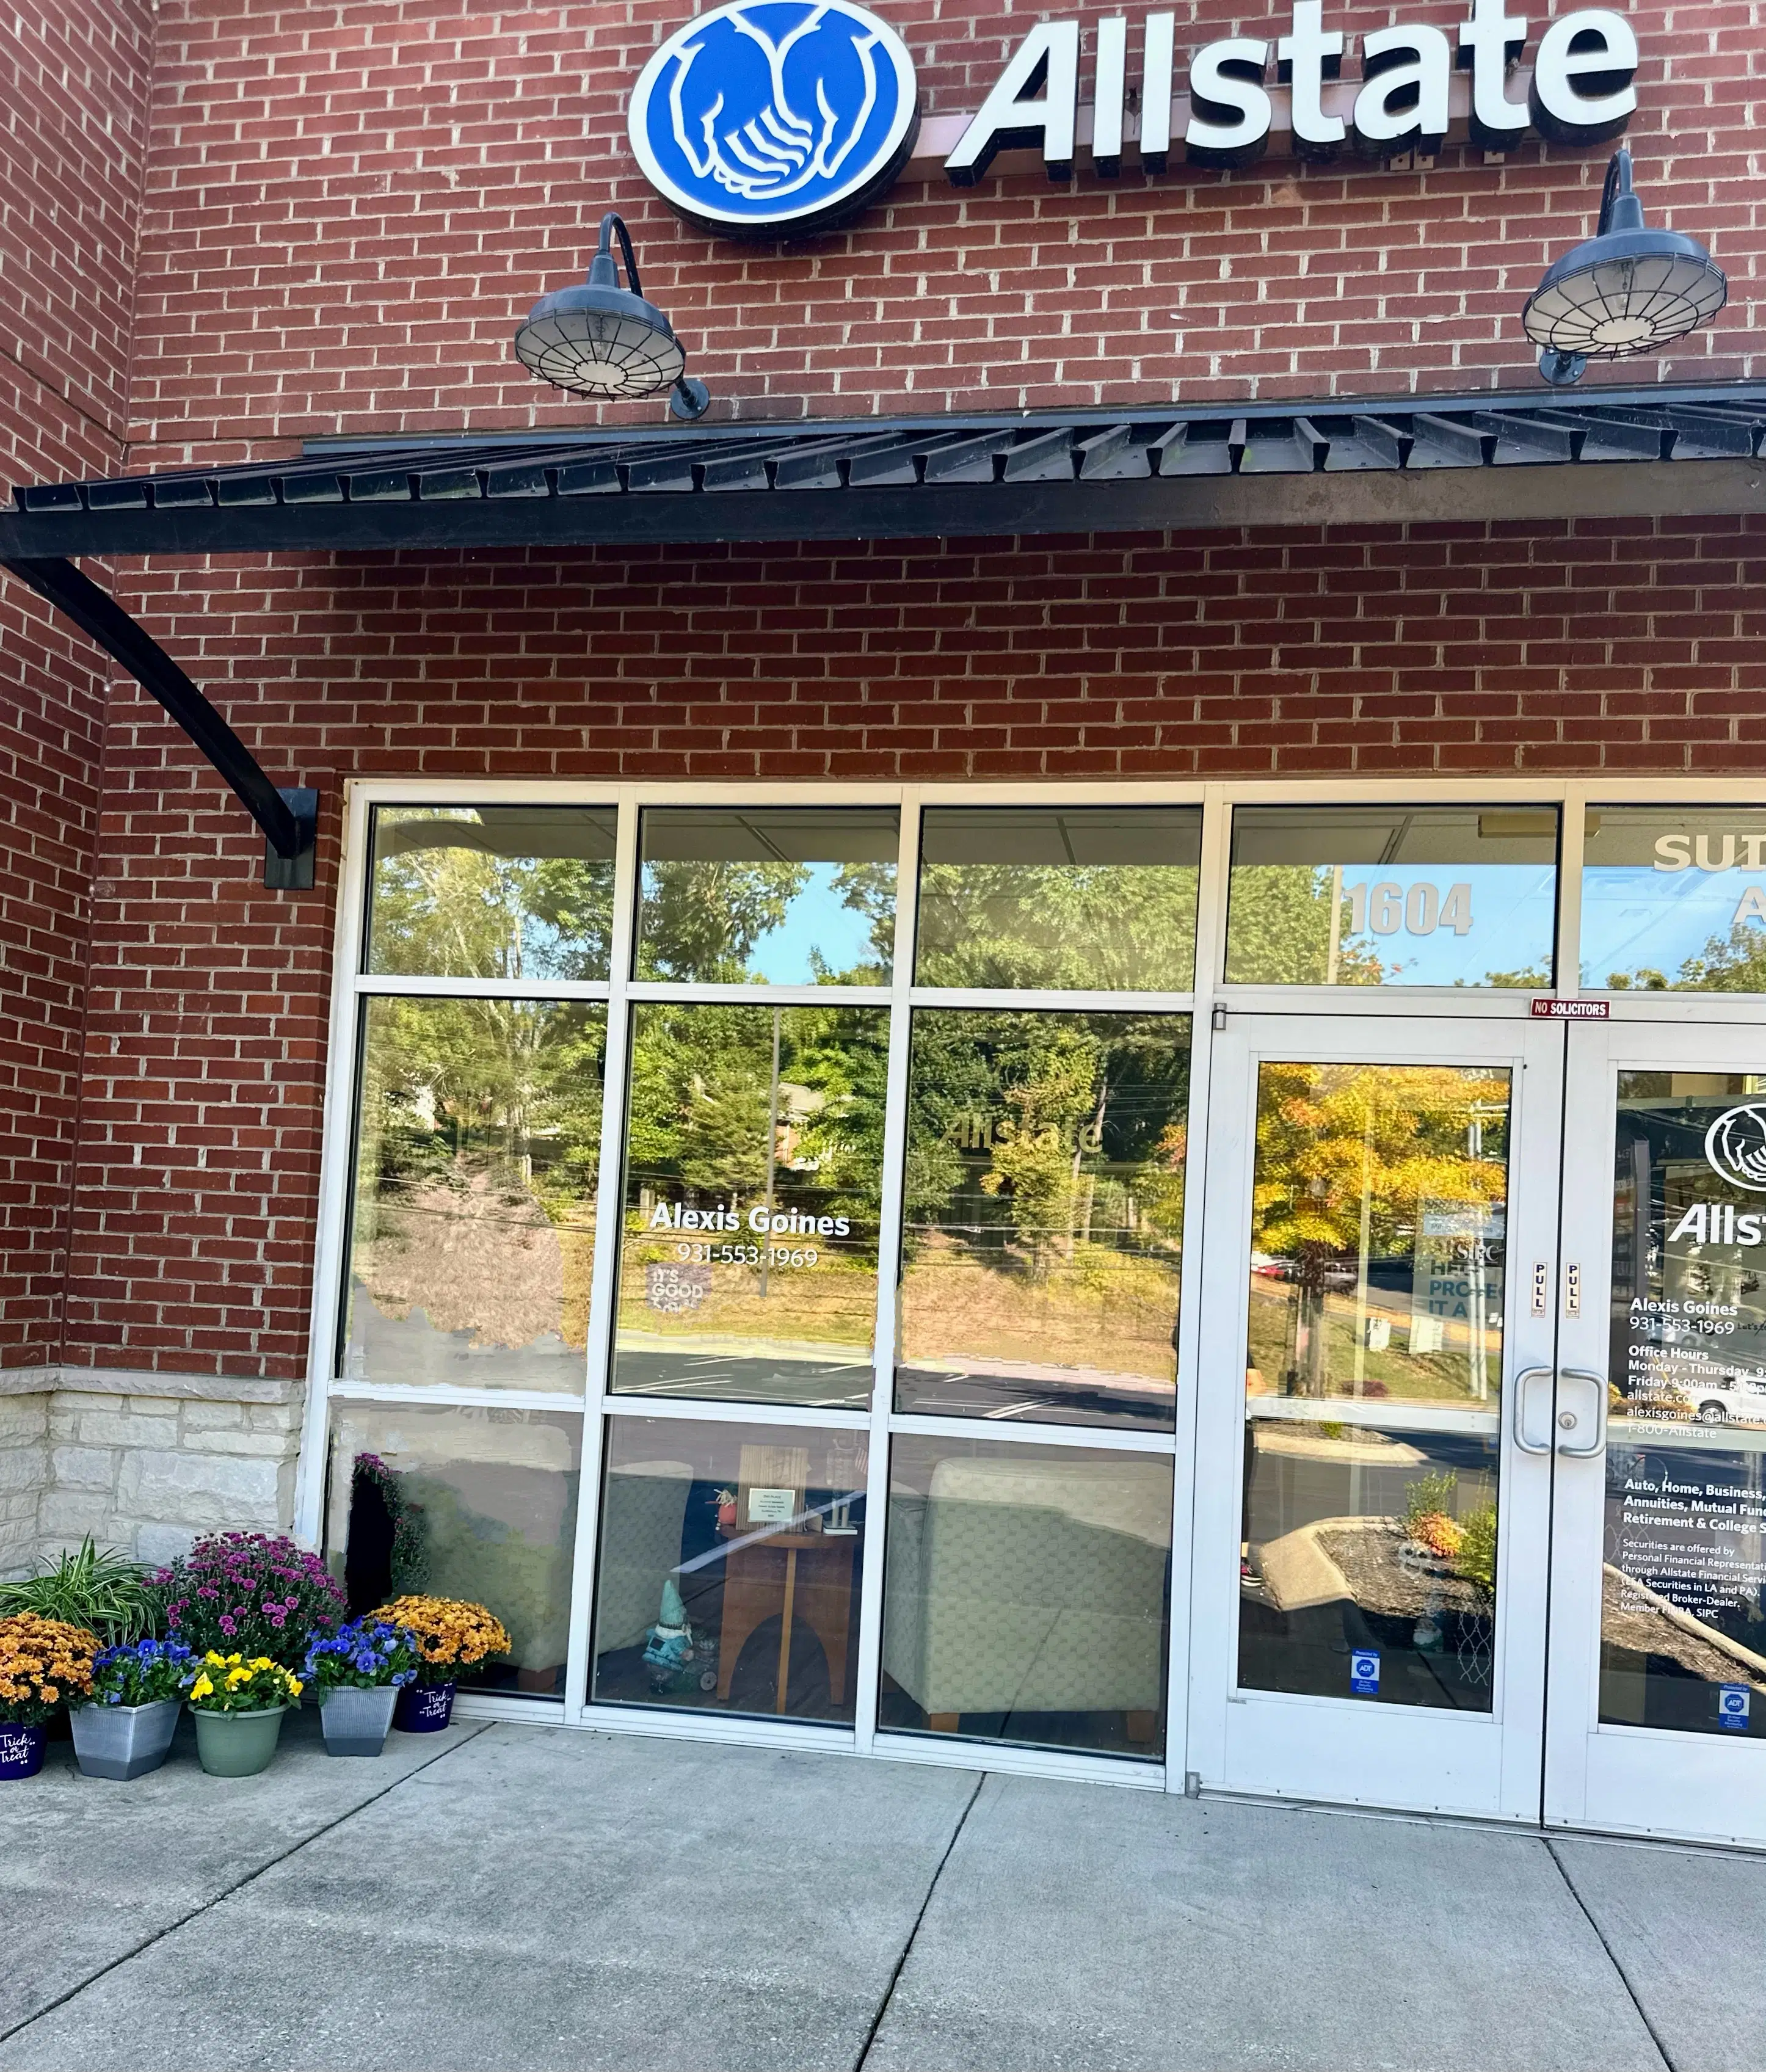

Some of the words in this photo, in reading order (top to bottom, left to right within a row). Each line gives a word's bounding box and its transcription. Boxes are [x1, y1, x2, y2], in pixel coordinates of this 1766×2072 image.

[944, 0, 1638, 169] Allstate
[1343, 882, 1474, 936] 1604
[1535, 1001, 1547, 1014] NO
[1550, 1002, 1606, 1016] SOLICITORS
[650, 1202, 739, 1231] Alexis
[748, 1205, 850, 1237] Goines
[1667, 1204, 1766, 1246] Alls
[677, 1243, 818, 1268] 931-553-1969
[652, 1282, 703, 1298] GOOD
[1535, 1264, 1545, 1307] PULL
[1569, 1265, 1578, 1308] PULL
[1630, 1298, 1679, 1313] Alexis
[1683, 1300, 1738, 1316] Goines
[1629, 1316, 1735, 1335] 931-553-1969
[1629, 1345, 1668, 1358] Office
[1670, 1348, 1709, 1360] Hours
[1628, 1359, 1679, 1375] Monday
[1688, 1363, 1750, 1376] Thursday
[1628, 1375, 1668, 1390] Friday
[1671, 1378, 1717, 1389] 9:00am
[1627, 1389, 1696, 1403] allstate.co
[1624, 1478, 1660, 1494] Auto,
[1662, 1481, 1703, 1497] Home,
[1706, 1485, 1766, 1502] Business,
[1624, 1495, 1689, 1513] Annuities,
[1691, 1500, 1737, 1514] Mutual
[1623, 1512, 1694, 1529] Retirement
[1696, 1518, 1707, 1530] &
[1709, 1519, 1757, 1535] College
[1622, 1538, 1668, 1551] Securities
[1687, 1544, 1721, 1555] offered
[1723, 1547, 1735, 1557] by
[1622, 1551, 1662, 1563] Personal
[1664, 1555, 1705, 1566] Financial
[1621, 1565, 1658, 1576] through
[1660, 1567, 1696, 1578] Allstate
[1698, 1570, 1740, 1582] Financial
[1646, 1579, 1692, 1591] Securities
[1693, 1583, 1703, 1591] in
[1704, 1583, 1718, 1593] LA
[1719, 1586, 1737, 1595] and
[1672, 1594, 1740, 1608] Broker-Dealer.
[1620, 1602, 1660, 1613] Member
[1696, 1609, 1719, 1618] SIPC
[423, 1690, 449, 1703] Trick
[423, 1701, 447, 1717] Treat
[0, 1733, 31, 1748] Trick
[0, 1745, 29, 1763] Treat
